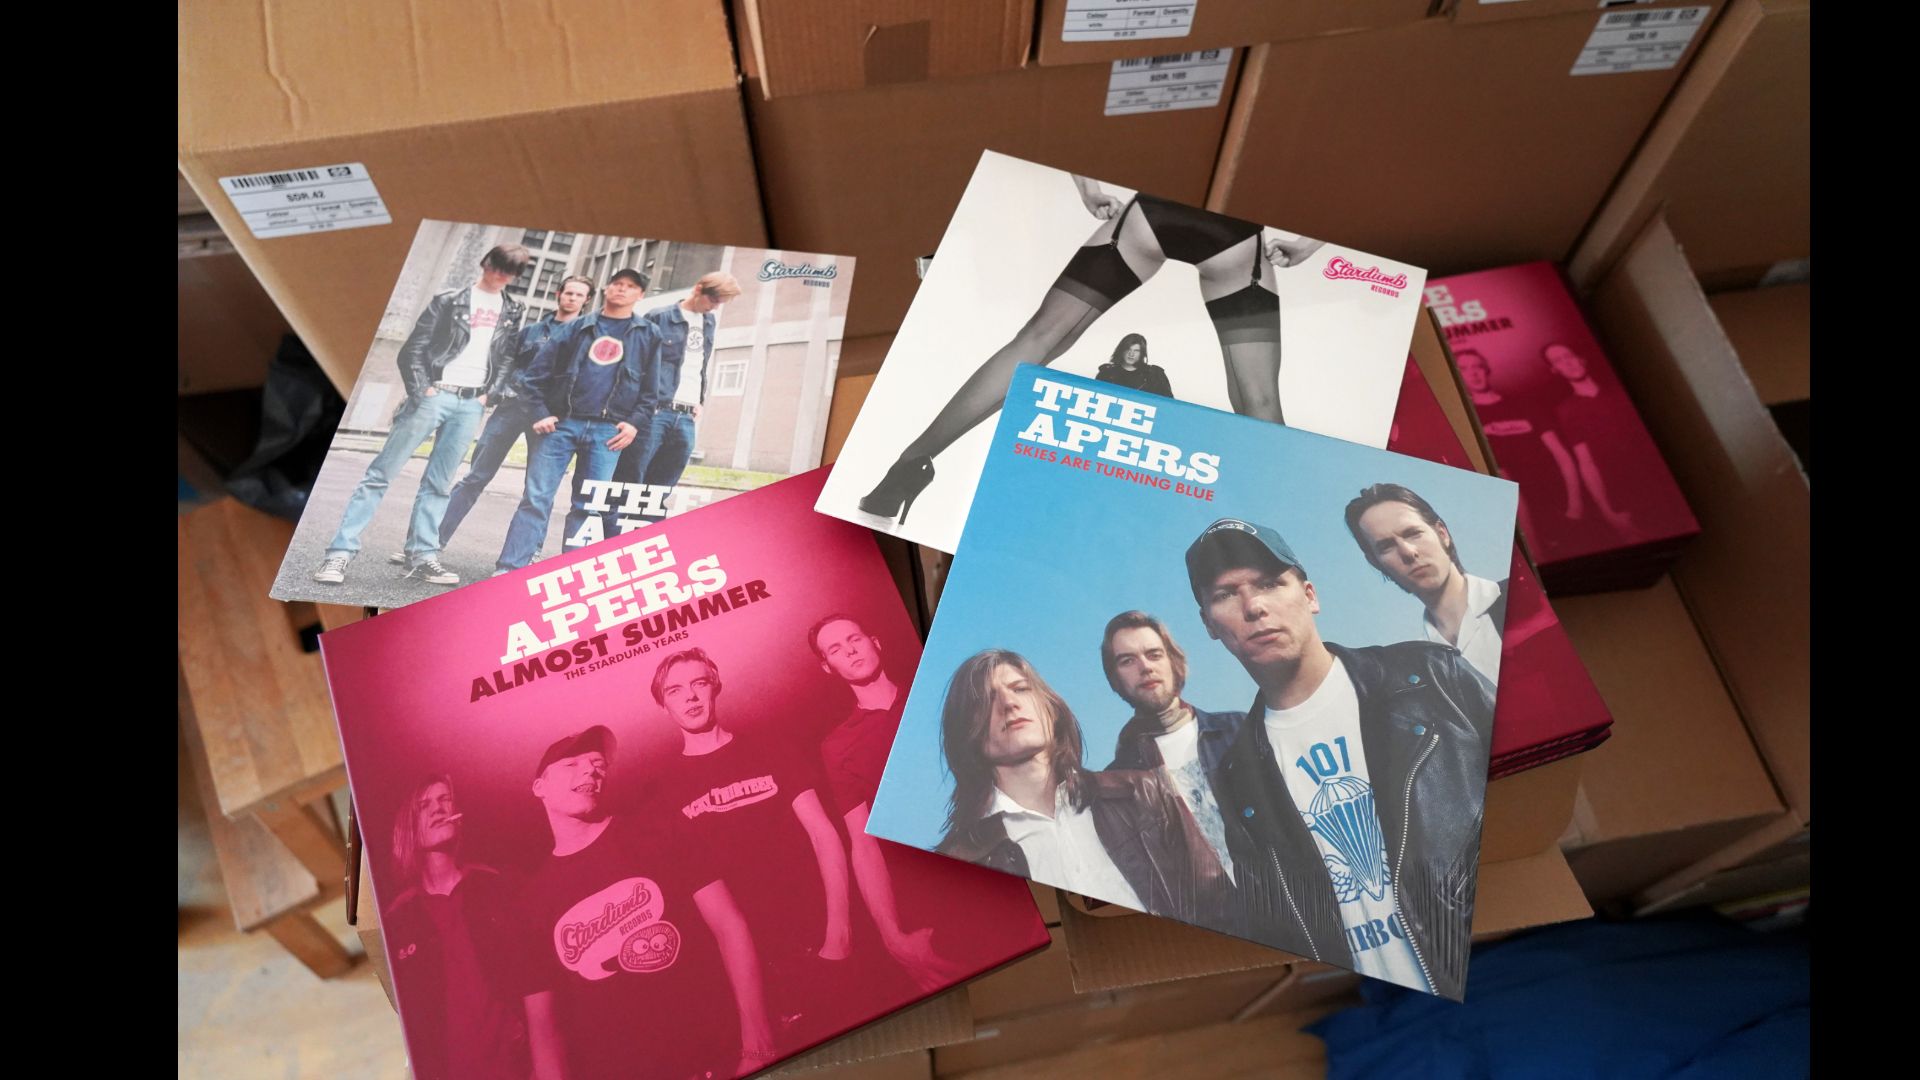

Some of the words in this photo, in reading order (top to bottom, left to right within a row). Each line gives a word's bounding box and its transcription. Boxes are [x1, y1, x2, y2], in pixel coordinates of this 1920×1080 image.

[1086, 11, 1108, 20] Colour
[1132, 9, 1156, 17] Format
[1163, 7, 1189, 16] Quantity
[758, 259, 838, 281] Stardumb
[1323, 256, 1407, 289] Stardumb
[1371, 284, 1399, 298] RECORDS
[1032, 378, 1157, 434] THE
[1014, 442, 1057, 463] SKIES
[1060, 454, 1092, 471] ARE
[1096, 461, 1171, 491] TURNING
[1175, 484, 1215, 502] BLUE
[1017, 412, 1220, 485] APERS
[525, 533, 679, 610] THE
[499, 553, 728, 665] APERS
[469, 633, 609, 703] ALMOST
[622, 578, 772, 647] SUMMER
[563, 666, 586, 681] THE
[588, 643, 651, 673] STARDUMB
[651, 629, 690, 649] YEARS
[1295, 735, 1352, 786] 101
[560, 882, 652, 965] Stardumb
[618, 909, 653, 936] RECORDS
